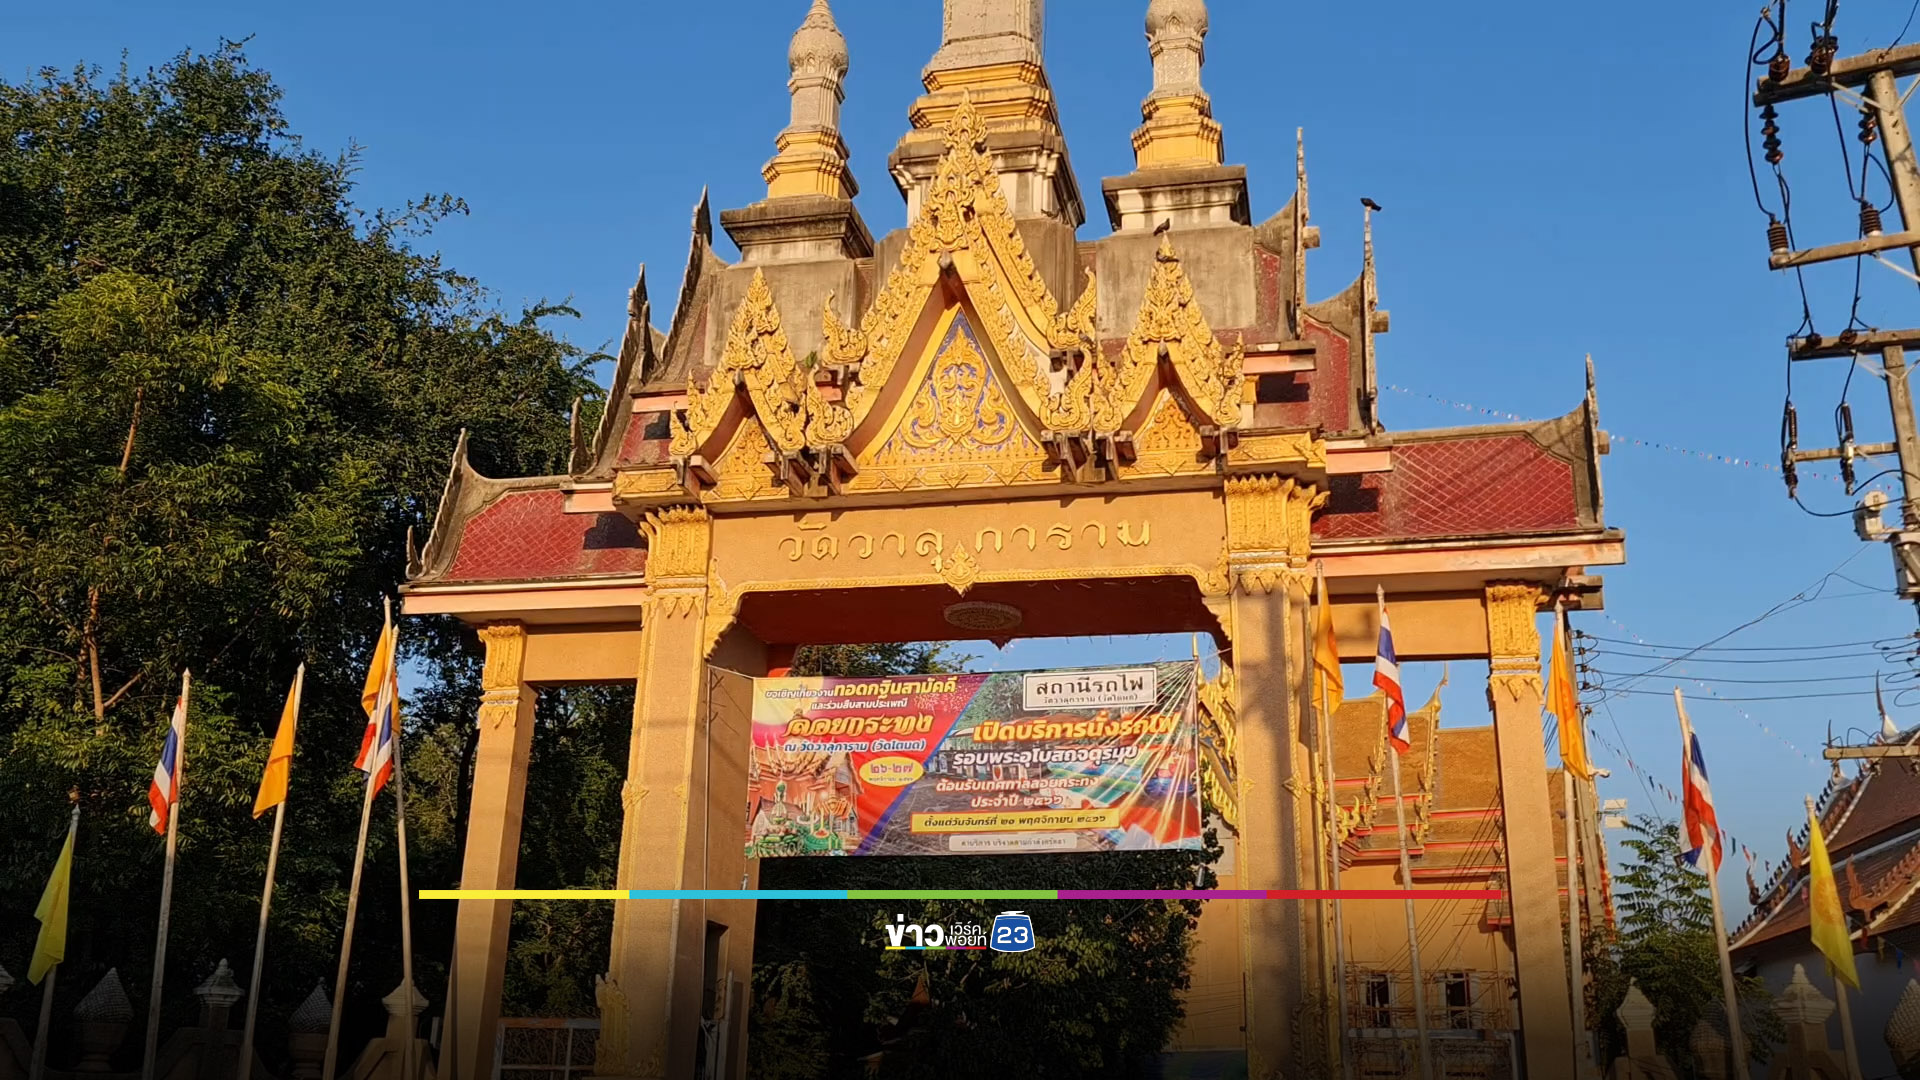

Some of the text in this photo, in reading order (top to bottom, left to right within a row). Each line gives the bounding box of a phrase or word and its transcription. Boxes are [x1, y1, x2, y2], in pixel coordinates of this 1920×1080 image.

[1036, 674, 1144, 695] สถานีรถไฟ
[973, 709, 1177, 742] เปิดบริการนั่งรถไฟ
[971, 792, 1020, 808] ประจำปี
